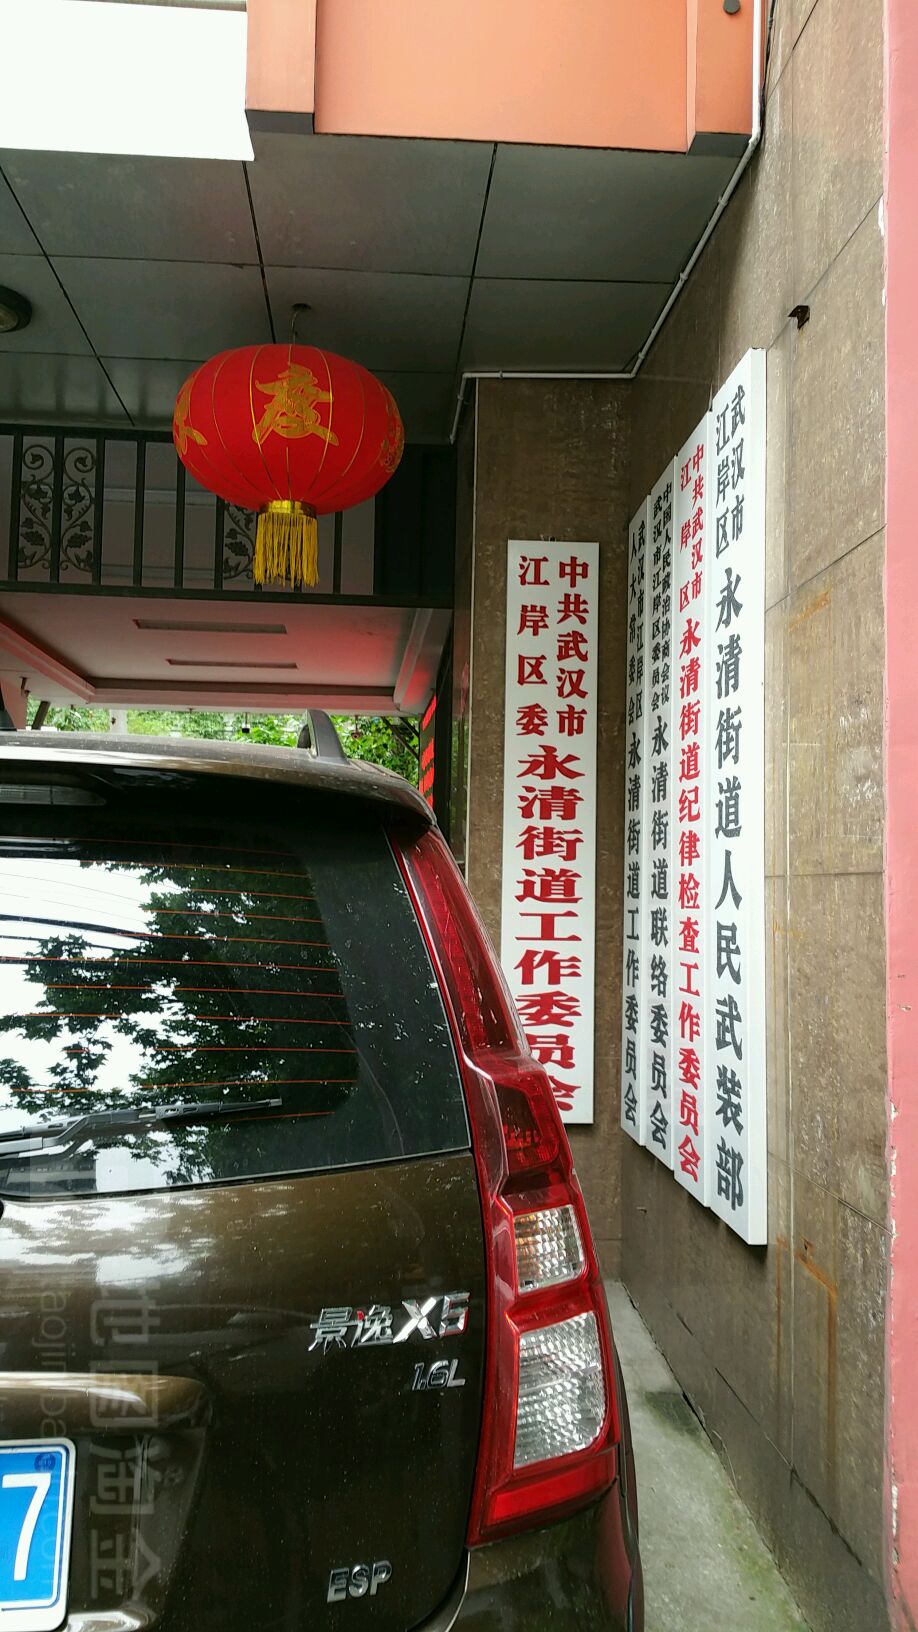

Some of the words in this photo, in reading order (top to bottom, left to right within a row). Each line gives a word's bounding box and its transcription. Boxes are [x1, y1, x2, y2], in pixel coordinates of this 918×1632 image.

[679, 457, 692, 614] 江岸区
[690, 443, 705, 601] 中共武汉市
[715, 403, 730, 560] 江岸区
[730, 384, 746, 544] 武汉市
[515, 555, 550, 737] 江岸区委
[556, 556, 590, 737] 中共武汉市
[628, 533, 639, 727] 人大常委会
[635, 520, 646, 720] 武汉市江岸区
[650, 496, 663, 712] 武汉市江岸区委员会
[660, 483, 673, 707] 中国人民政治协商会议
[624, 732, 642, 1127] 永清街道工作委员会
[650, 715, 670, 1151] 永清街道联络委员会
[678, 618, 702, 1183] 永清街道纪律检查工作委员会
[714, 566, 744, 1210] 永清街道人民武装部
[411, 1359, 466, 1390] 1.6L
[326, 1560, 393, 1602] ESP
